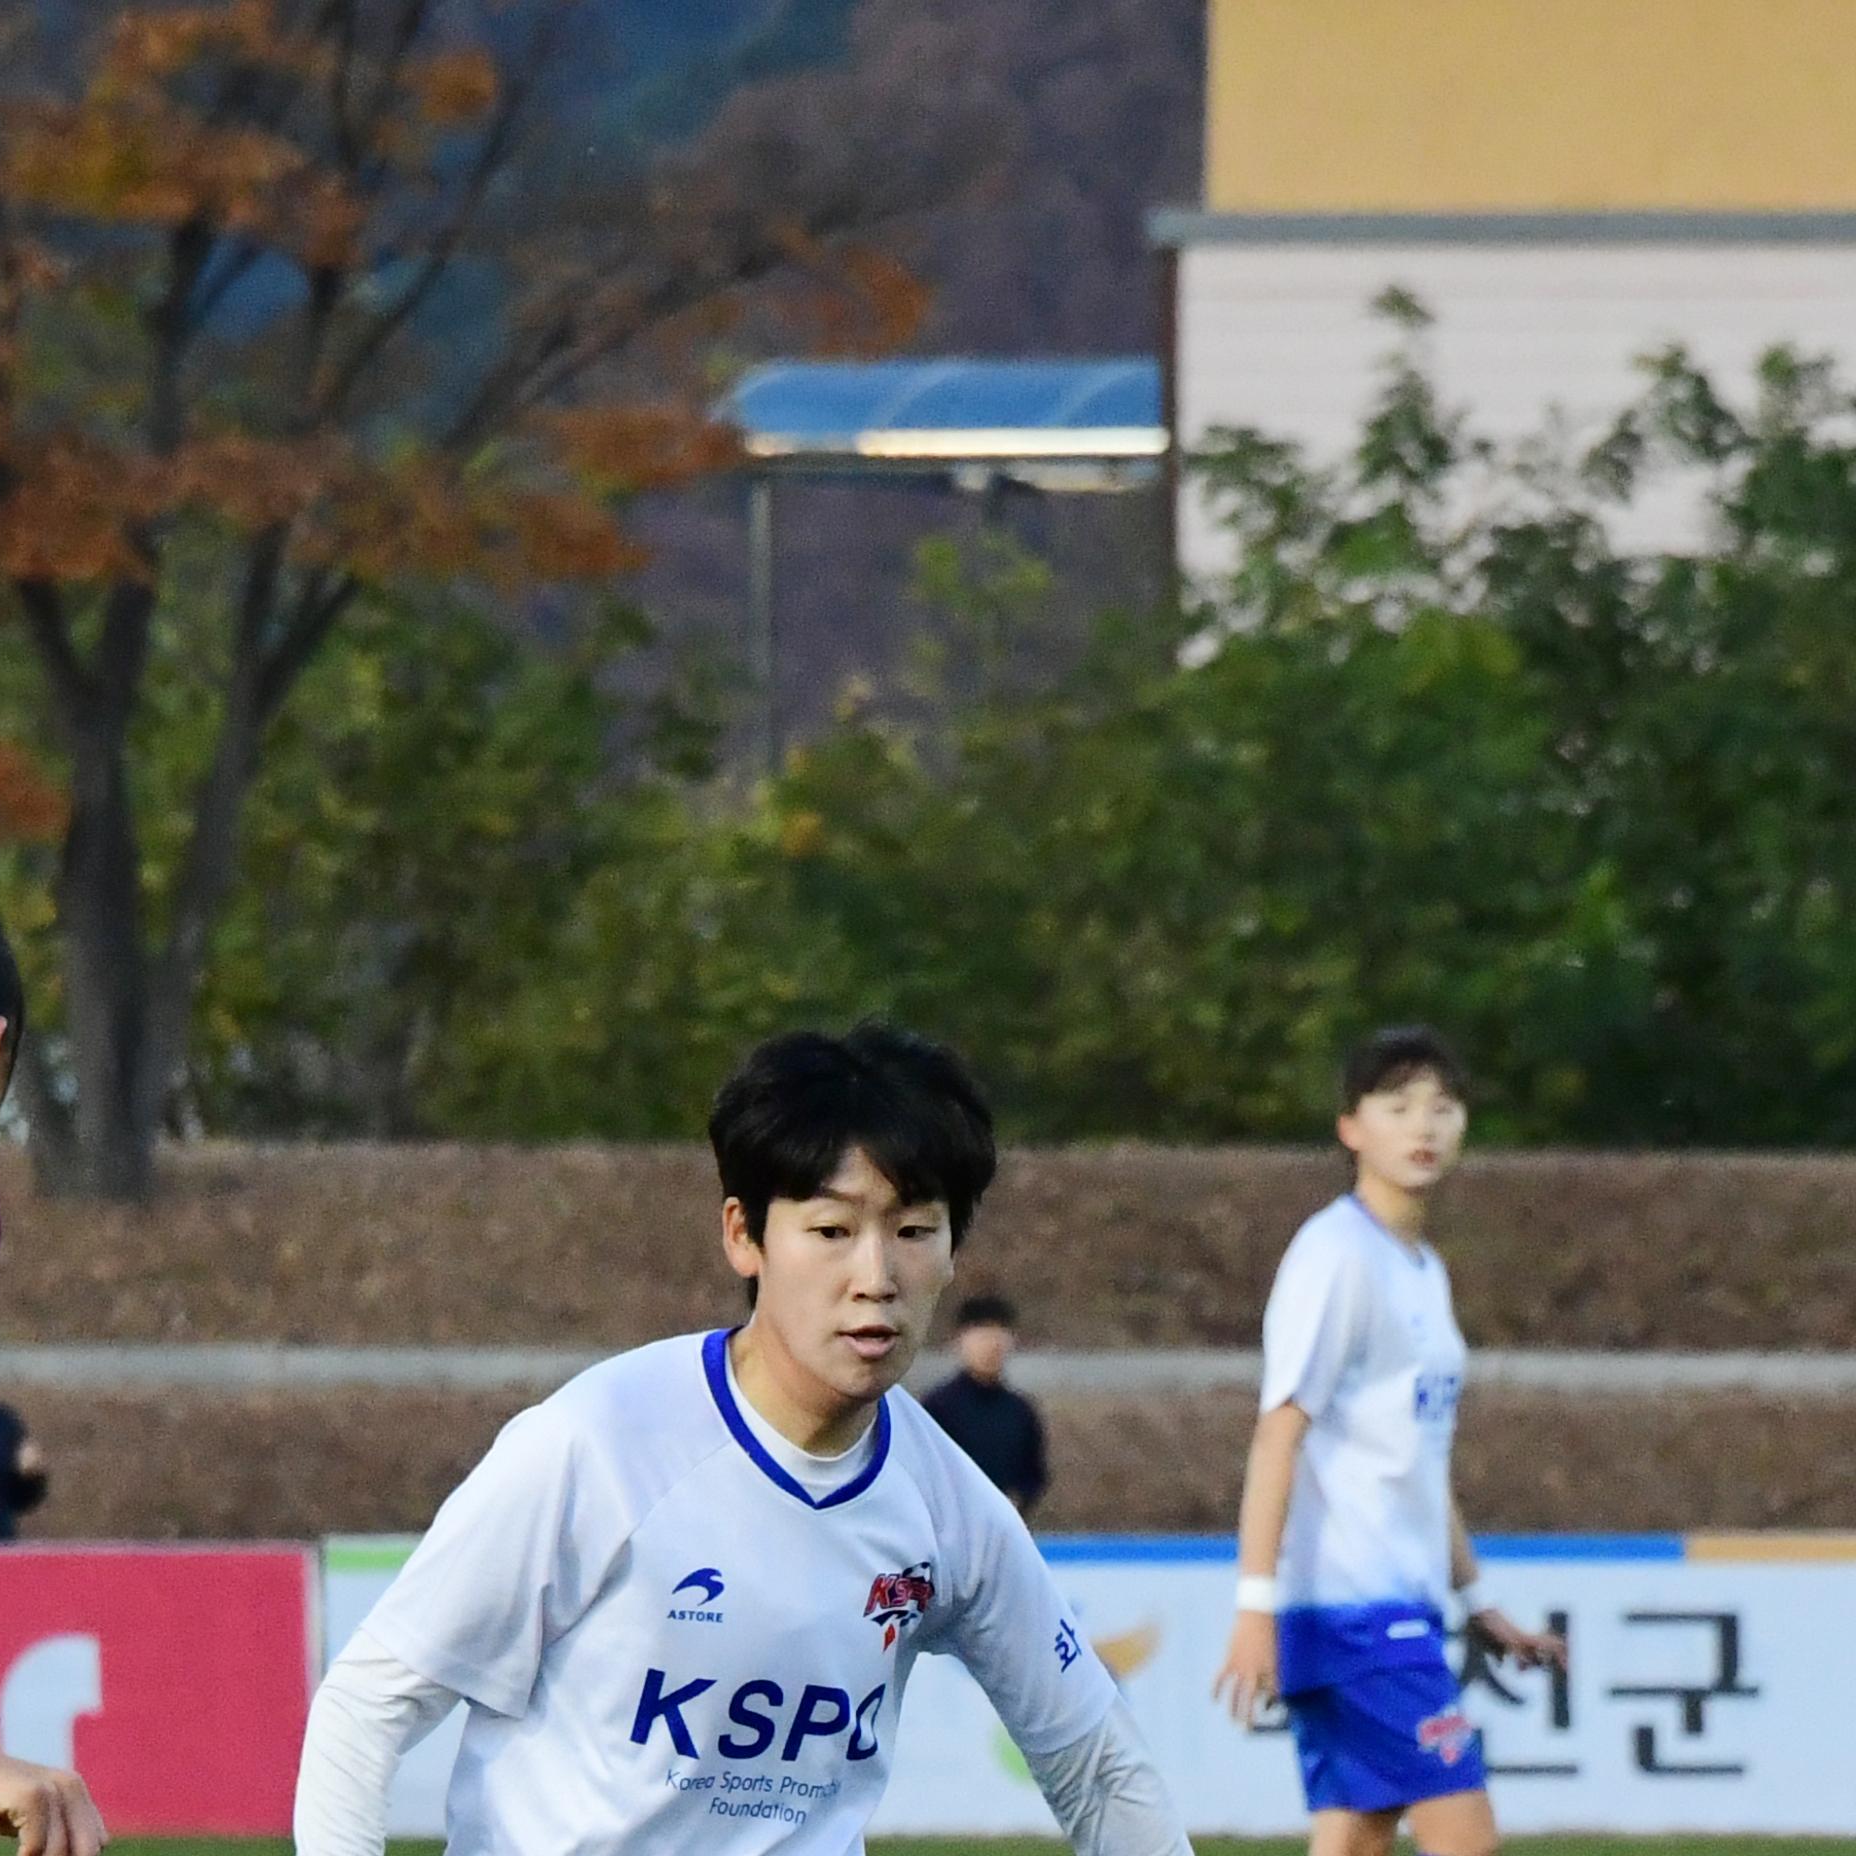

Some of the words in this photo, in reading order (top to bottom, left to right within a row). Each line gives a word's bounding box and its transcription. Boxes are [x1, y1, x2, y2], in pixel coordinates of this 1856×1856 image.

[667, 1609, 723, 1623] ASTORE
[630, 1668, 886, 1762] KSPO
[665, 1769, 715, 1791] Korea
[720, 1771, 773, 1793] Sports
[708, 1797, 806, 1824] Foundation
